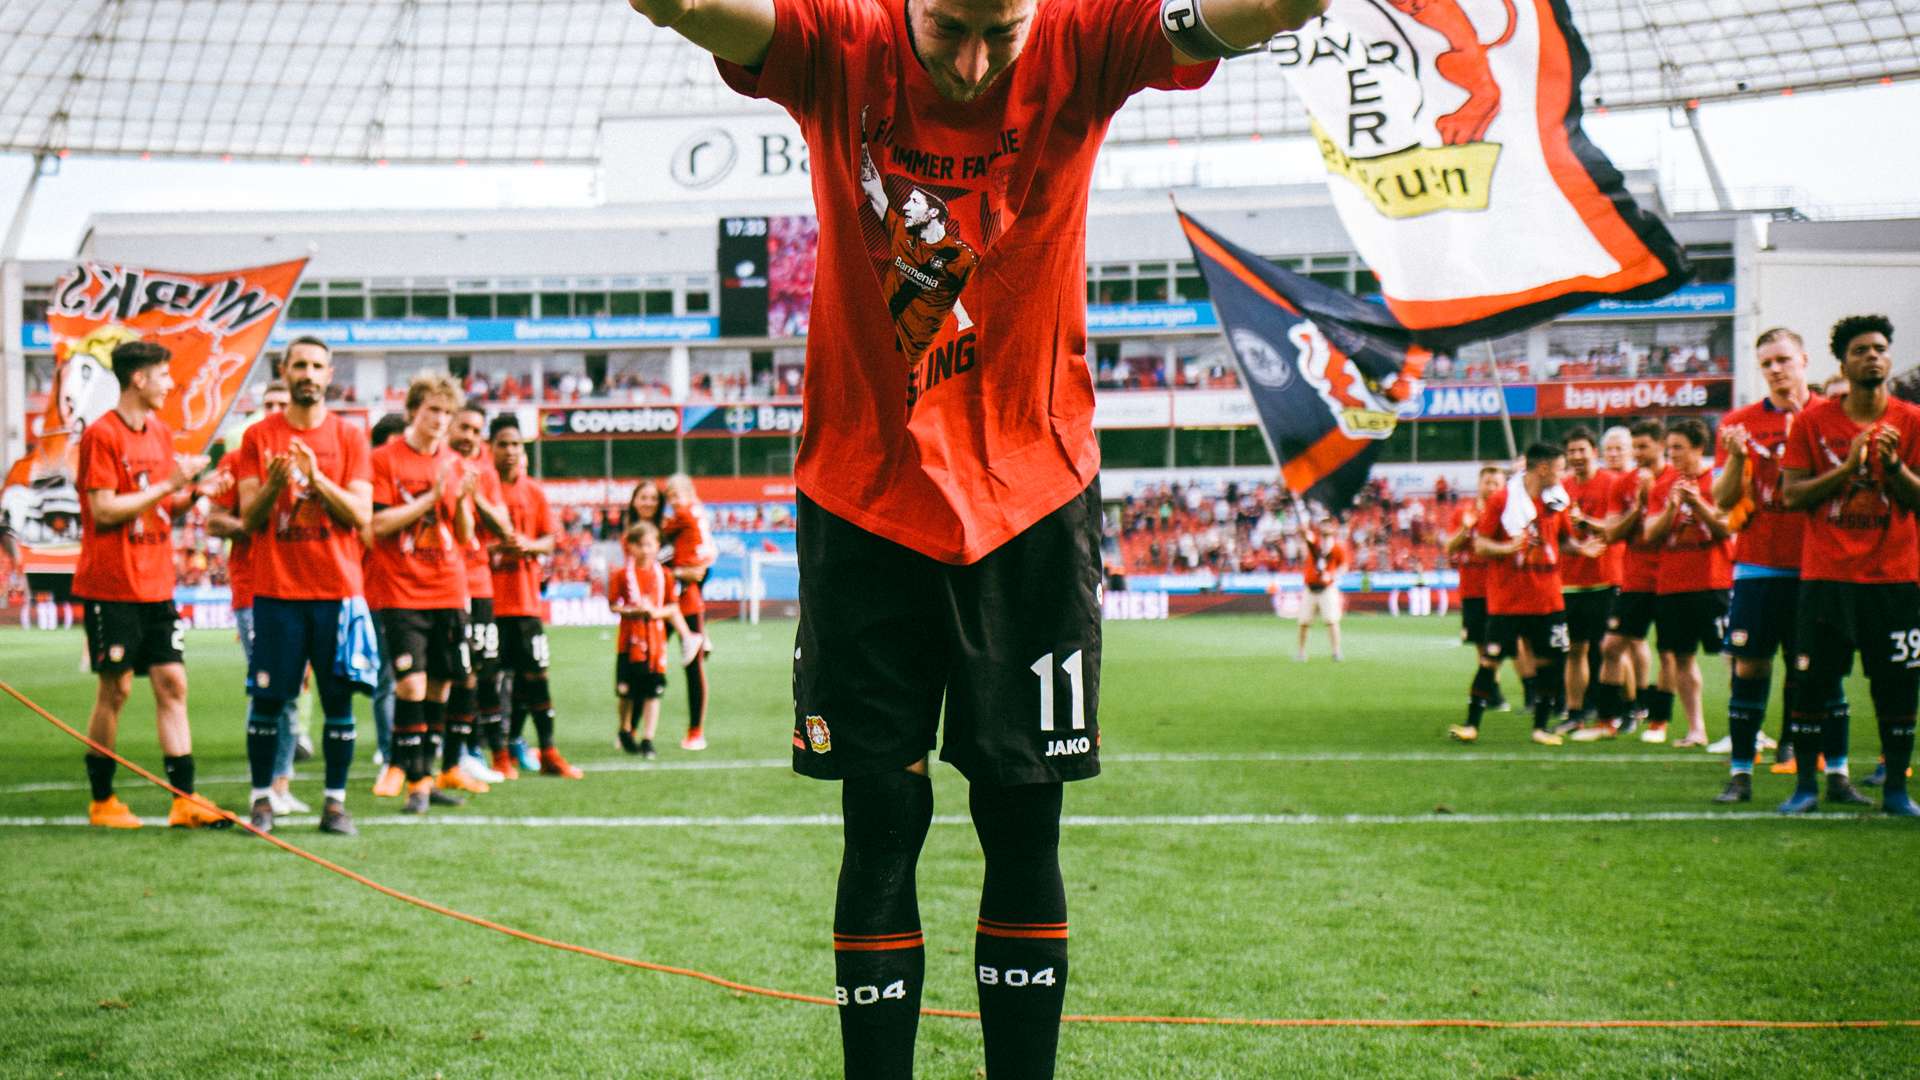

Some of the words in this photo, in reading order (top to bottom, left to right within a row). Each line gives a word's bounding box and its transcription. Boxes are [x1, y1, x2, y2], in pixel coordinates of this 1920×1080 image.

[894, 255, 940, 289] Barmenia
[1429, 387, 1501, 416] JAKO
[1564, 383, 1708, 413] bayer04.de
[570, 408, 679, 434] covestro
[1030, 649, 1085, 731] 11
[1045, 737, 1091, 757] JAKO
